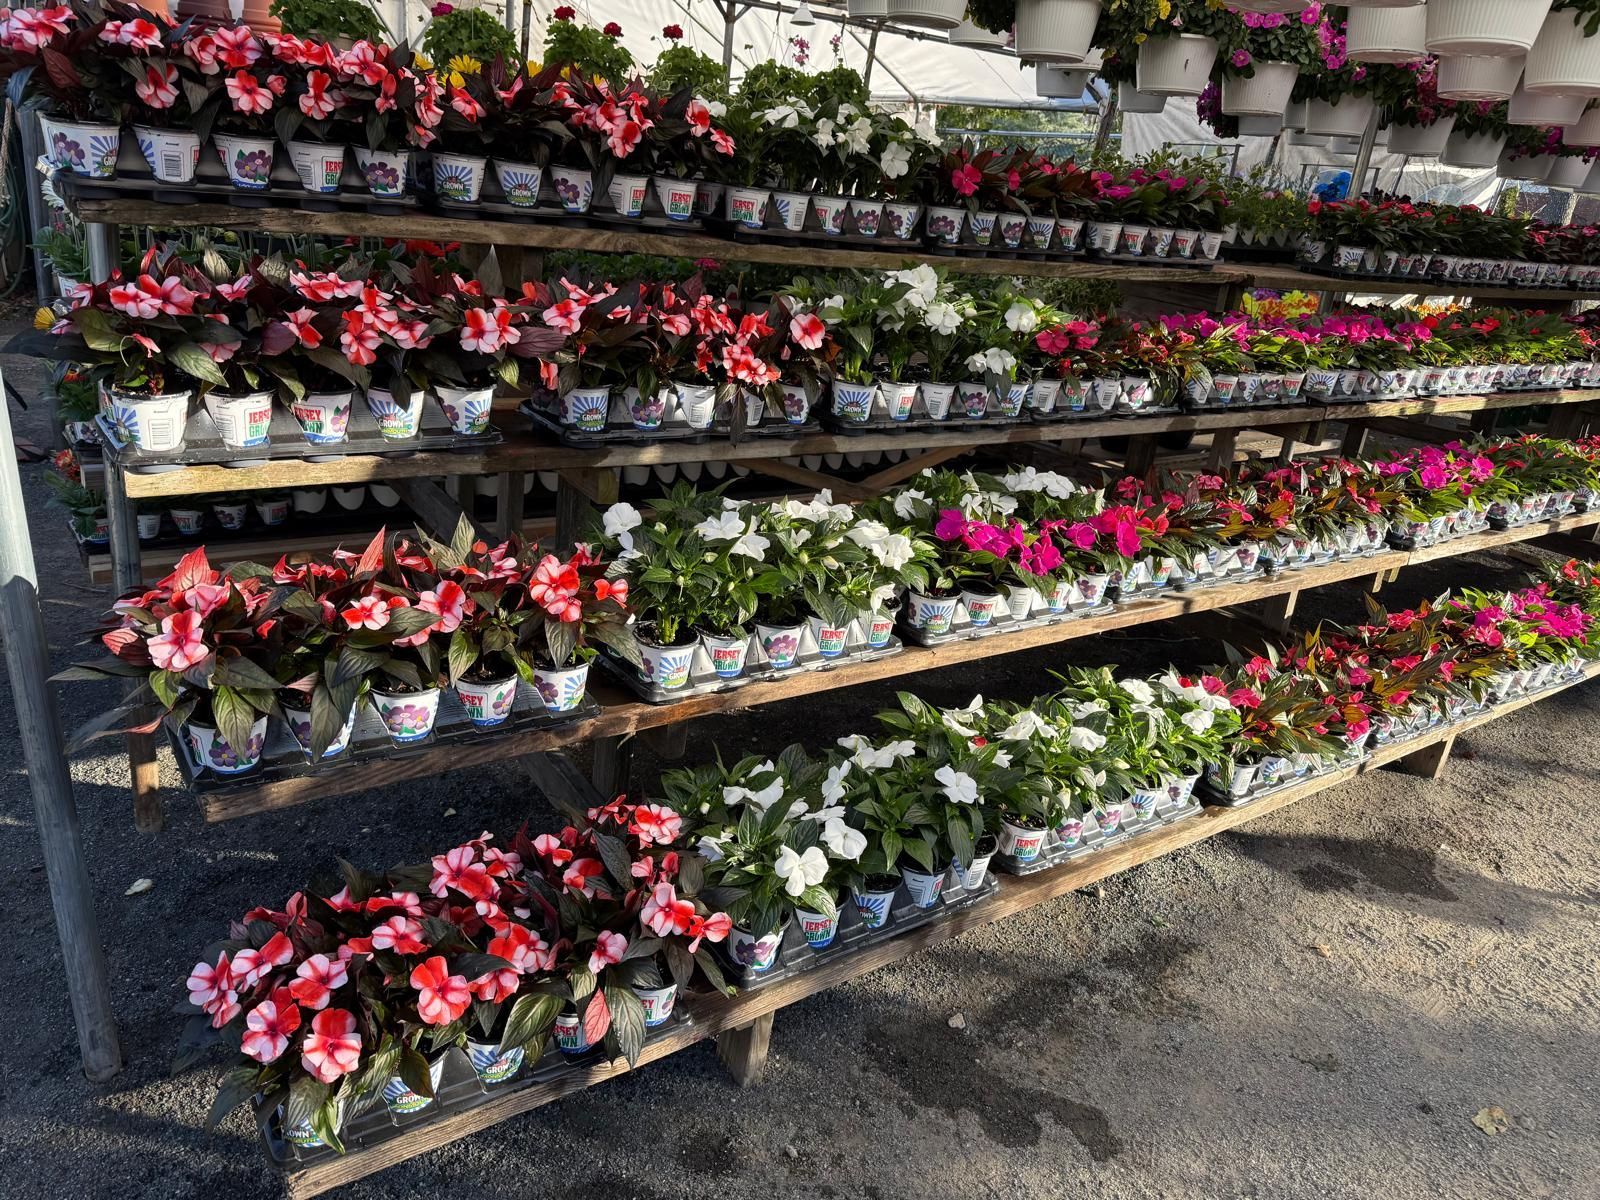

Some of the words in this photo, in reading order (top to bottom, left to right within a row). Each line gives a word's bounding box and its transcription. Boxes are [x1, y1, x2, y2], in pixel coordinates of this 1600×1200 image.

[443, 181, 464, 191] GROWN
[511, 188, 532, 197] GROWN
[671, 192, 692, 203] JERSEY
[732, 199, 755, 210] JERSEY
[714, 648, 741, 660] JERSEY
[805, 918, 832, 932] JERSEY
